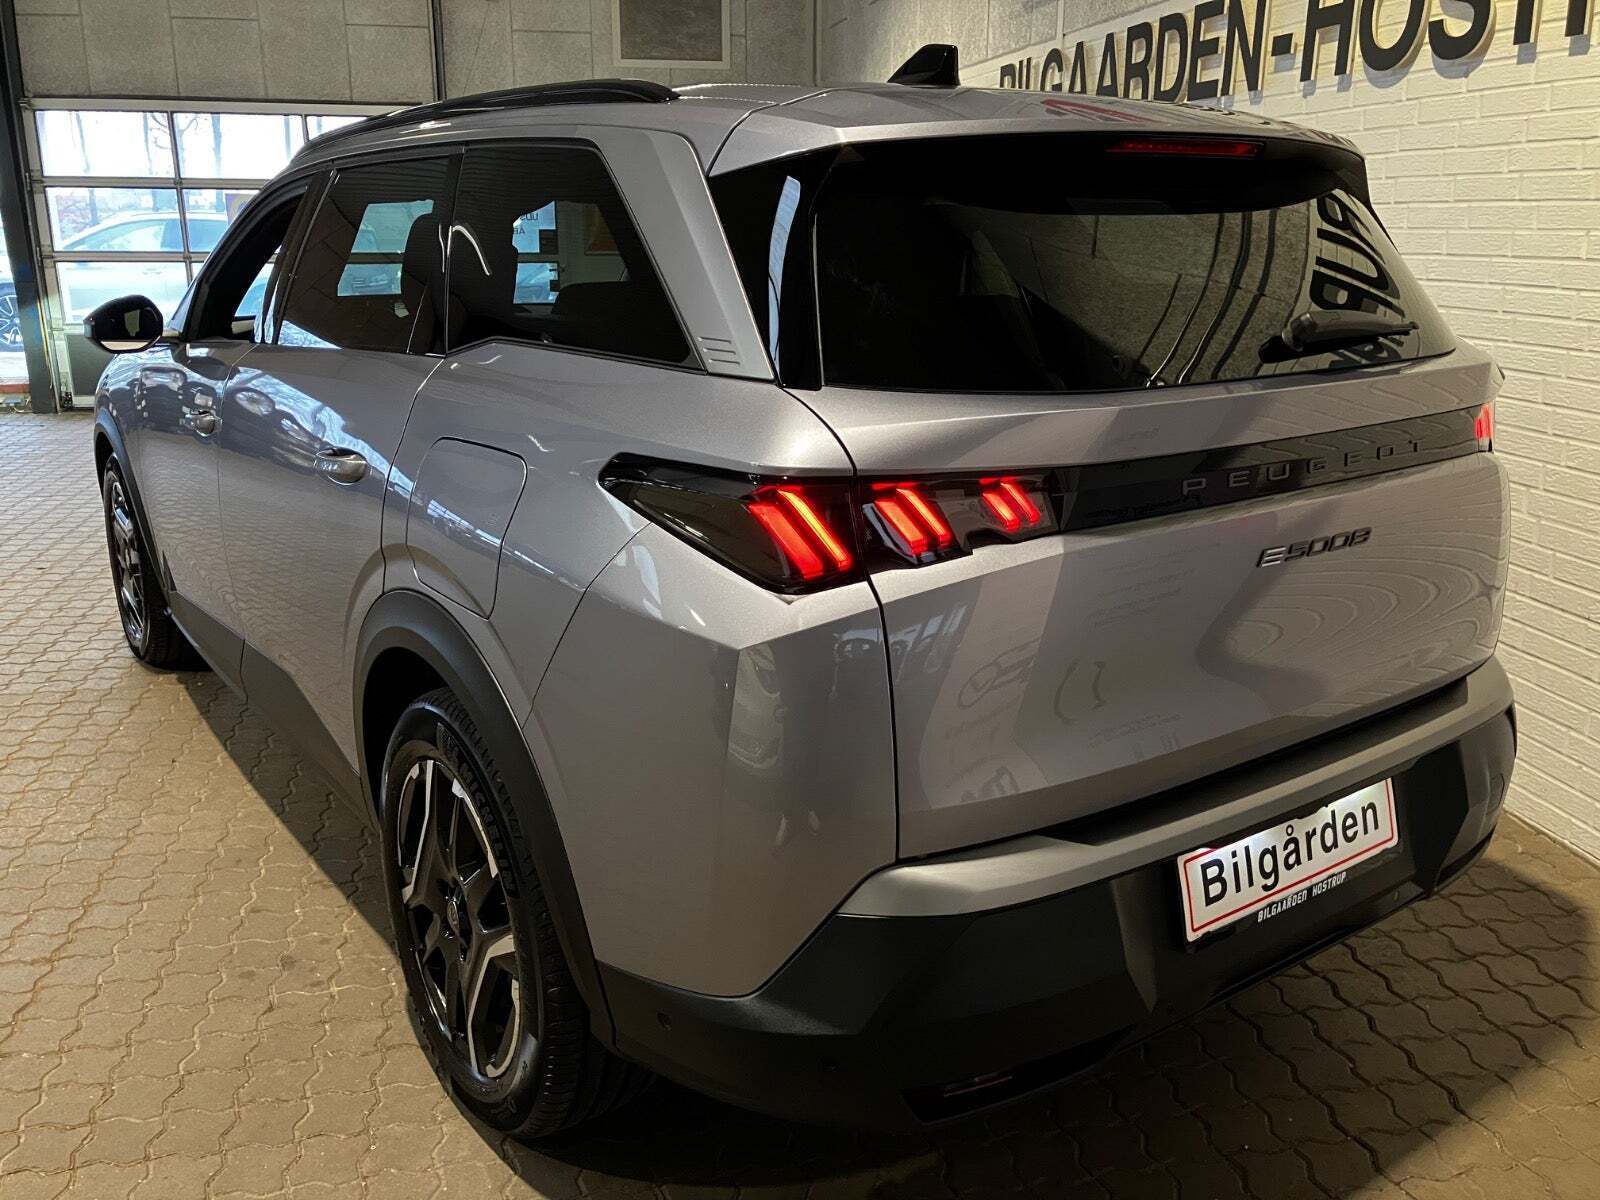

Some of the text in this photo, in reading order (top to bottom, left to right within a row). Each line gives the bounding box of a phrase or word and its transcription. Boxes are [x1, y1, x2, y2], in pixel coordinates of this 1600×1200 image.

[1000, 0, 1596, 103] GAARDEN-HO
[1181, 440, 1421, 497] PEUGEOT
[458, 762, 516, 891] MICHELIN
[1200, 801, 1380, 907] Bilgården
[1257, 871, 1347, 923] BILGAARDEN HOSTRUP
